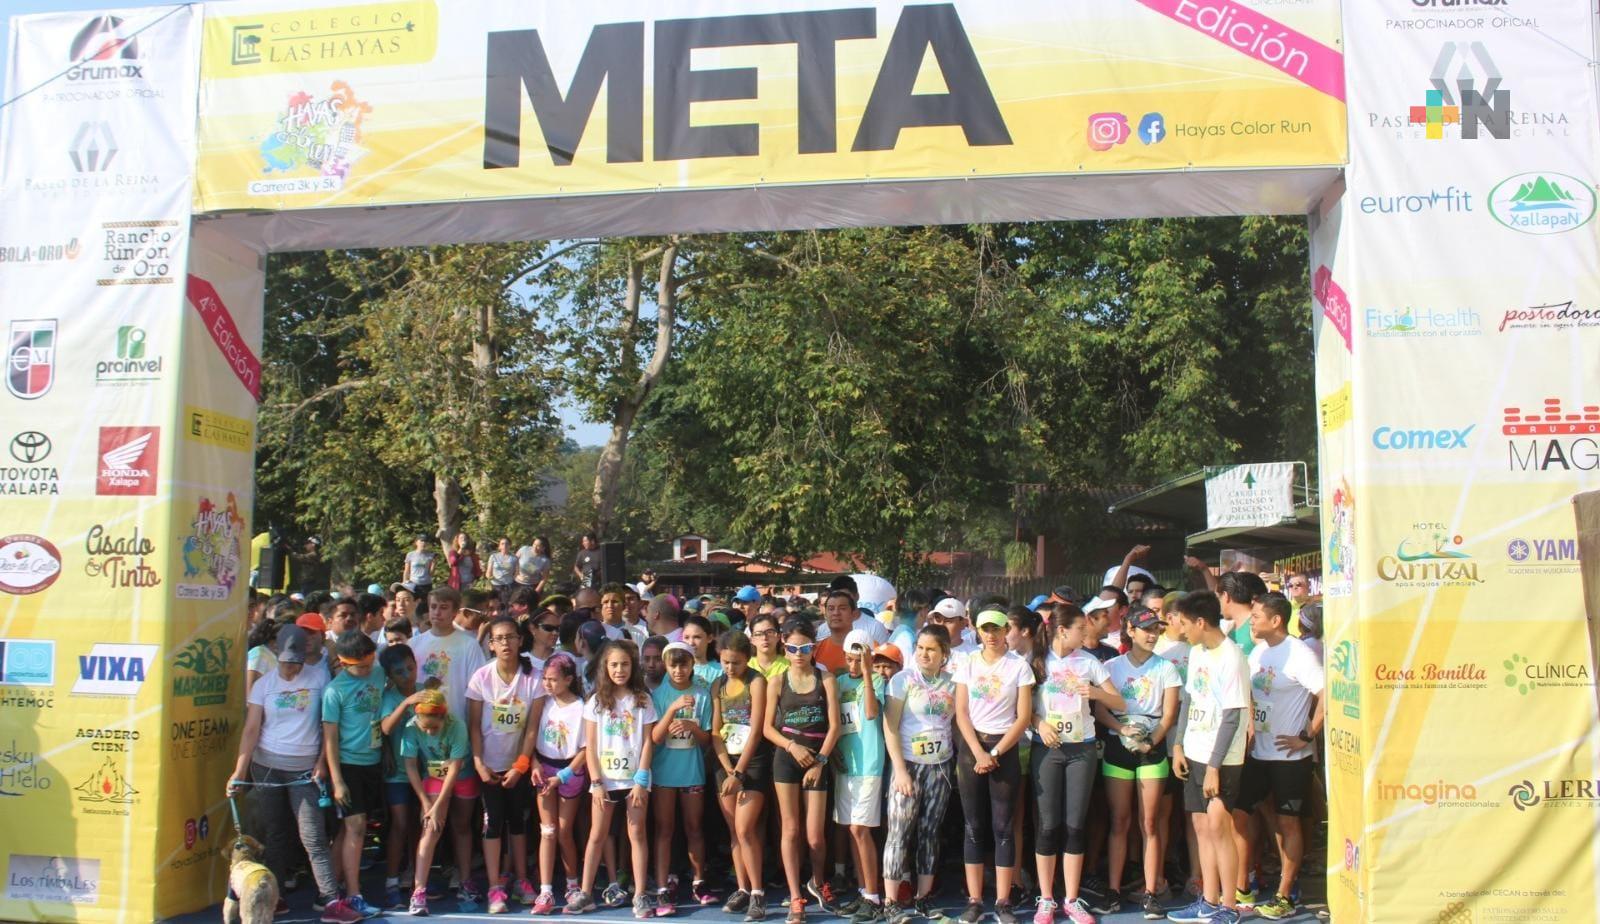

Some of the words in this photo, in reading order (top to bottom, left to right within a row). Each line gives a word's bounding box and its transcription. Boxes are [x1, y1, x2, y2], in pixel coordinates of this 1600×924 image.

[271, 12, 402, 34] COLEGIO
[1386, 18, 1484, 30] PATROCINADOR
[1492, 16, 1540, 28] OFICIAL
[269, 44, 312, 63] LAS
[320, 36, 401, 59] HAYAS
[66, 65, 143, 81] Grumax
[483, 2, 1014, 169] META
[1505, 109, 1569, 126] REINA
[1175, 123, 1225, 140] Hayas
[1231, 121, 1275, 136] Color
[1281, 120, 1312, 134] Run
[72, 177, 89, 189] DE
[115, 173, 160, 186] REINA
[252, 182, 295, 194] Carrera
[298, 181, 311, 191] 3k
[313, 183, 319, 192] y
[322, 179, 336, 190] 5k
[1509, 213, 1580, 228] XallapaN
[105, 229, 171, 245] Rancho
[113, 264, 126, 274] de
[133, 260, 169, 277] Oro
[212, 314, 255, 385] Edición
[96, 357, 162, 378] proinvel
[1372, 424, 1476, 450] Comex
[1509, 425, 1596, 434] GRUPO
[0, 467, 59, 481] TOYOTA
[102, 469, 149, 477] HONDA
[0, 483, 59, 495] XALAPA
[108, 478, 140, 487] Xalapa
[1413, 522, 1447, 530] HOTEL
[86, 524, 155, 555] Asado
[103, 556, 161, 588] Tinto
[79, 655, 145, 682] VIXA
[1375, 663, 1416, 681] Casa
[1421, 663, 1487, 681] Bonilla
[1525, 662, 1588, 679] CLÍNICA
[2, 697, 54, 708] HTEMOC
[498, 713, 520, 725] 405
[76, 728, 140, 741] ASADERO
[171, 722, 195, 741] ONE
[198, 717, 229, 737] TEAM
[1057, 721, 1073, 734] 99
[920, 741, 942, 755] 137
[0, 740, 33, 773] sky
[607, 757, 629, 770] 192
[1377, 780, 1477, 805] imagina
[1543, 780, 1600, 799] LER
[1438, 801, 1500, 809] promocionales
